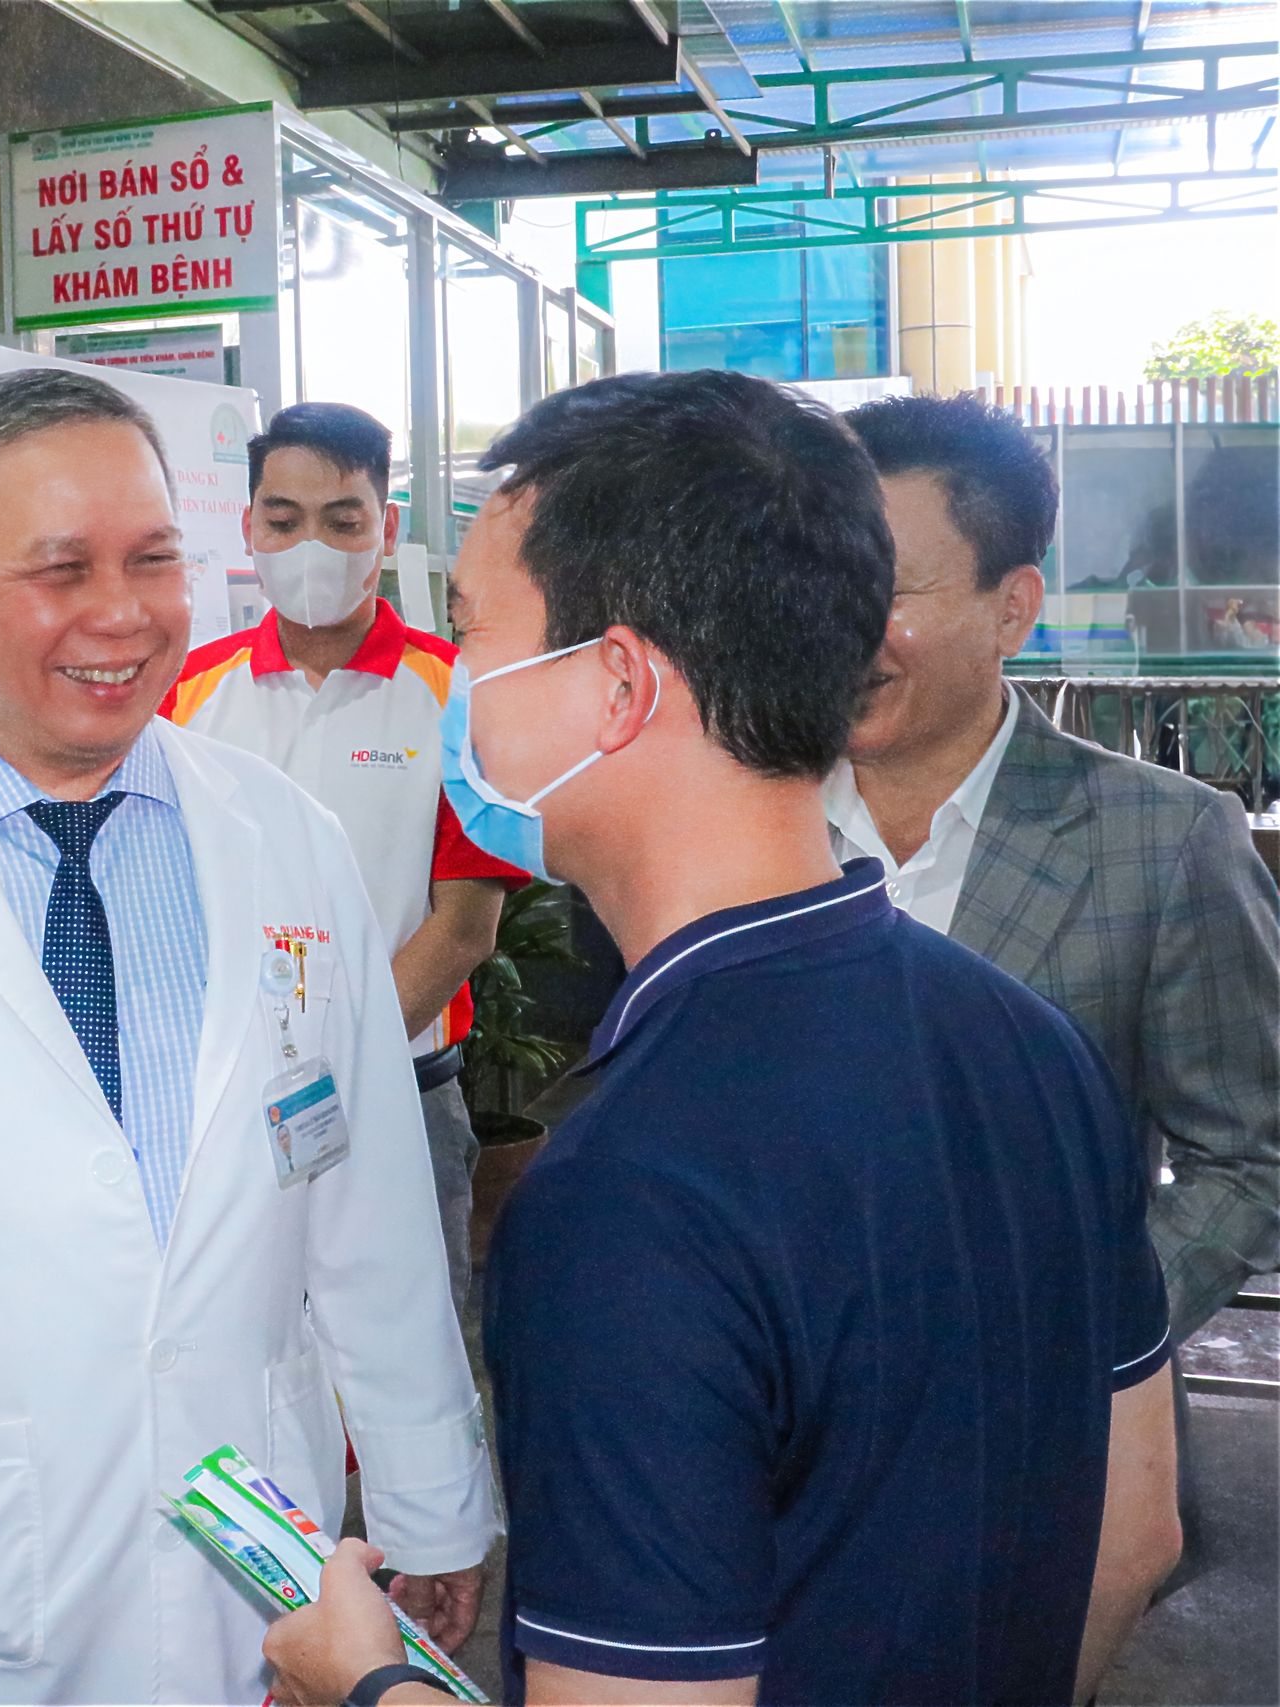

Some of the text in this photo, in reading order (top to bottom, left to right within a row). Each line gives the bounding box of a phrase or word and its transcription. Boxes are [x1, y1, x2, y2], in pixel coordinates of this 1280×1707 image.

[38, 144, 245, 208] NƠI BÁN SỔ &
[32, 200, 255, 258] LẤY SỐ THỨ TỰ
[53, 253, 233, 304] KHÁM BỆNH
[351, 749, 404, 764] HDBank
